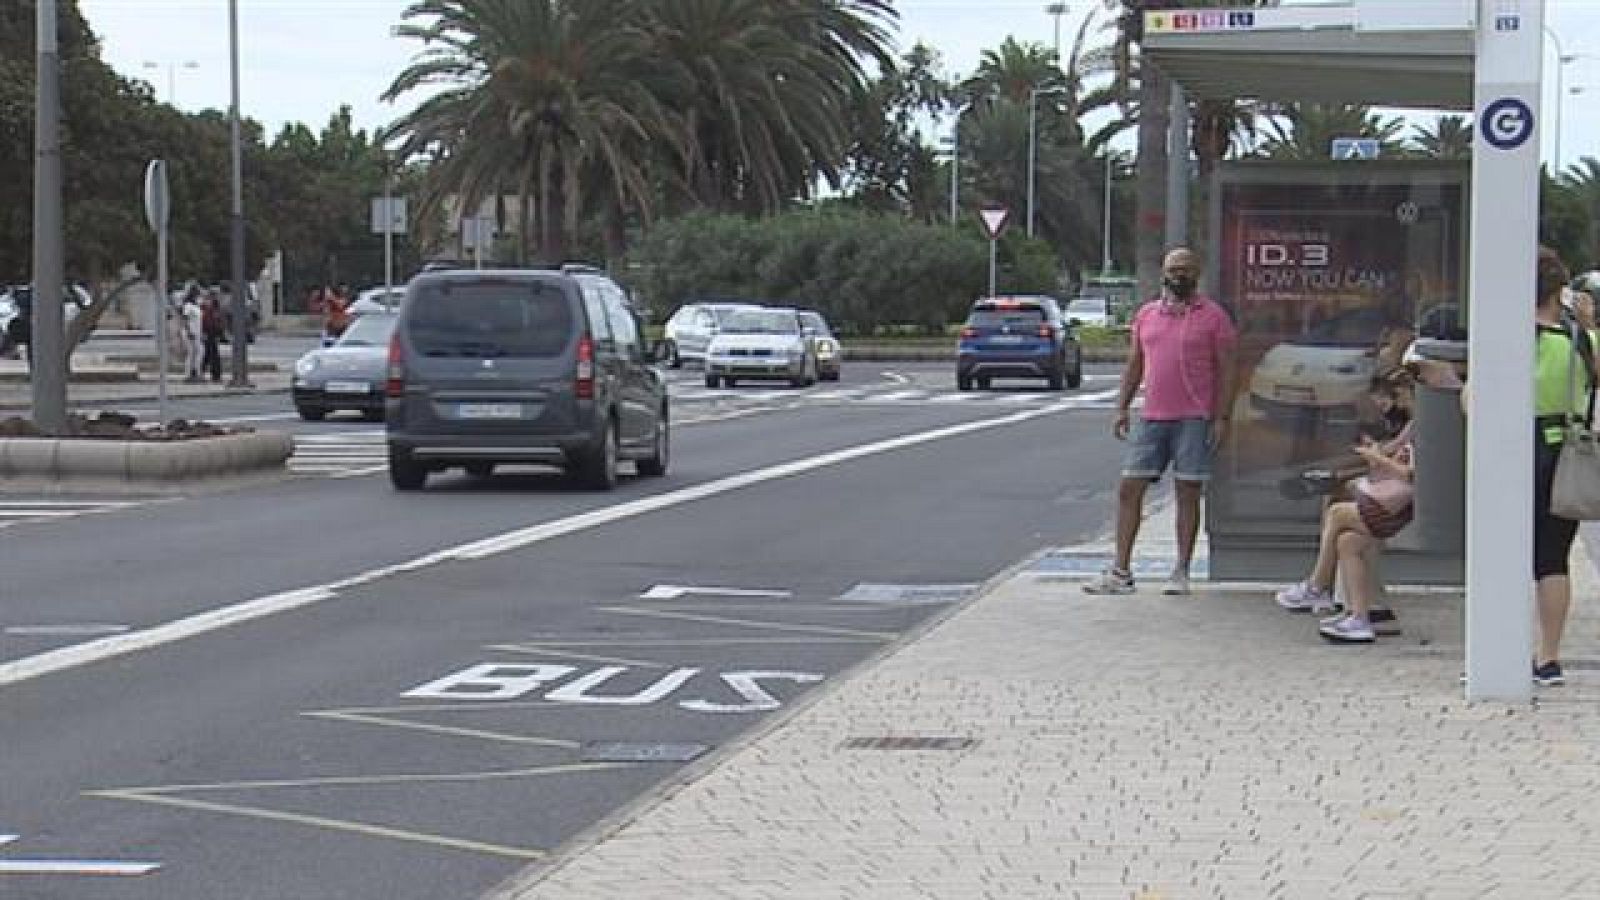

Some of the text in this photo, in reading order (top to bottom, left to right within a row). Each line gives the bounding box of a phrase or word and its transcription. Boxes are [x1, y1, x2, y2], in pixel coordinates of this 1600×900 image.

[1490, 108, 1525, 141] G
[1247, 244, 1329, 266] ID.3
[1247, 269, 1296, 289] NOW
[1300, 269, 1341, 289] YOU
[400, 662, 826, 713] BUS
